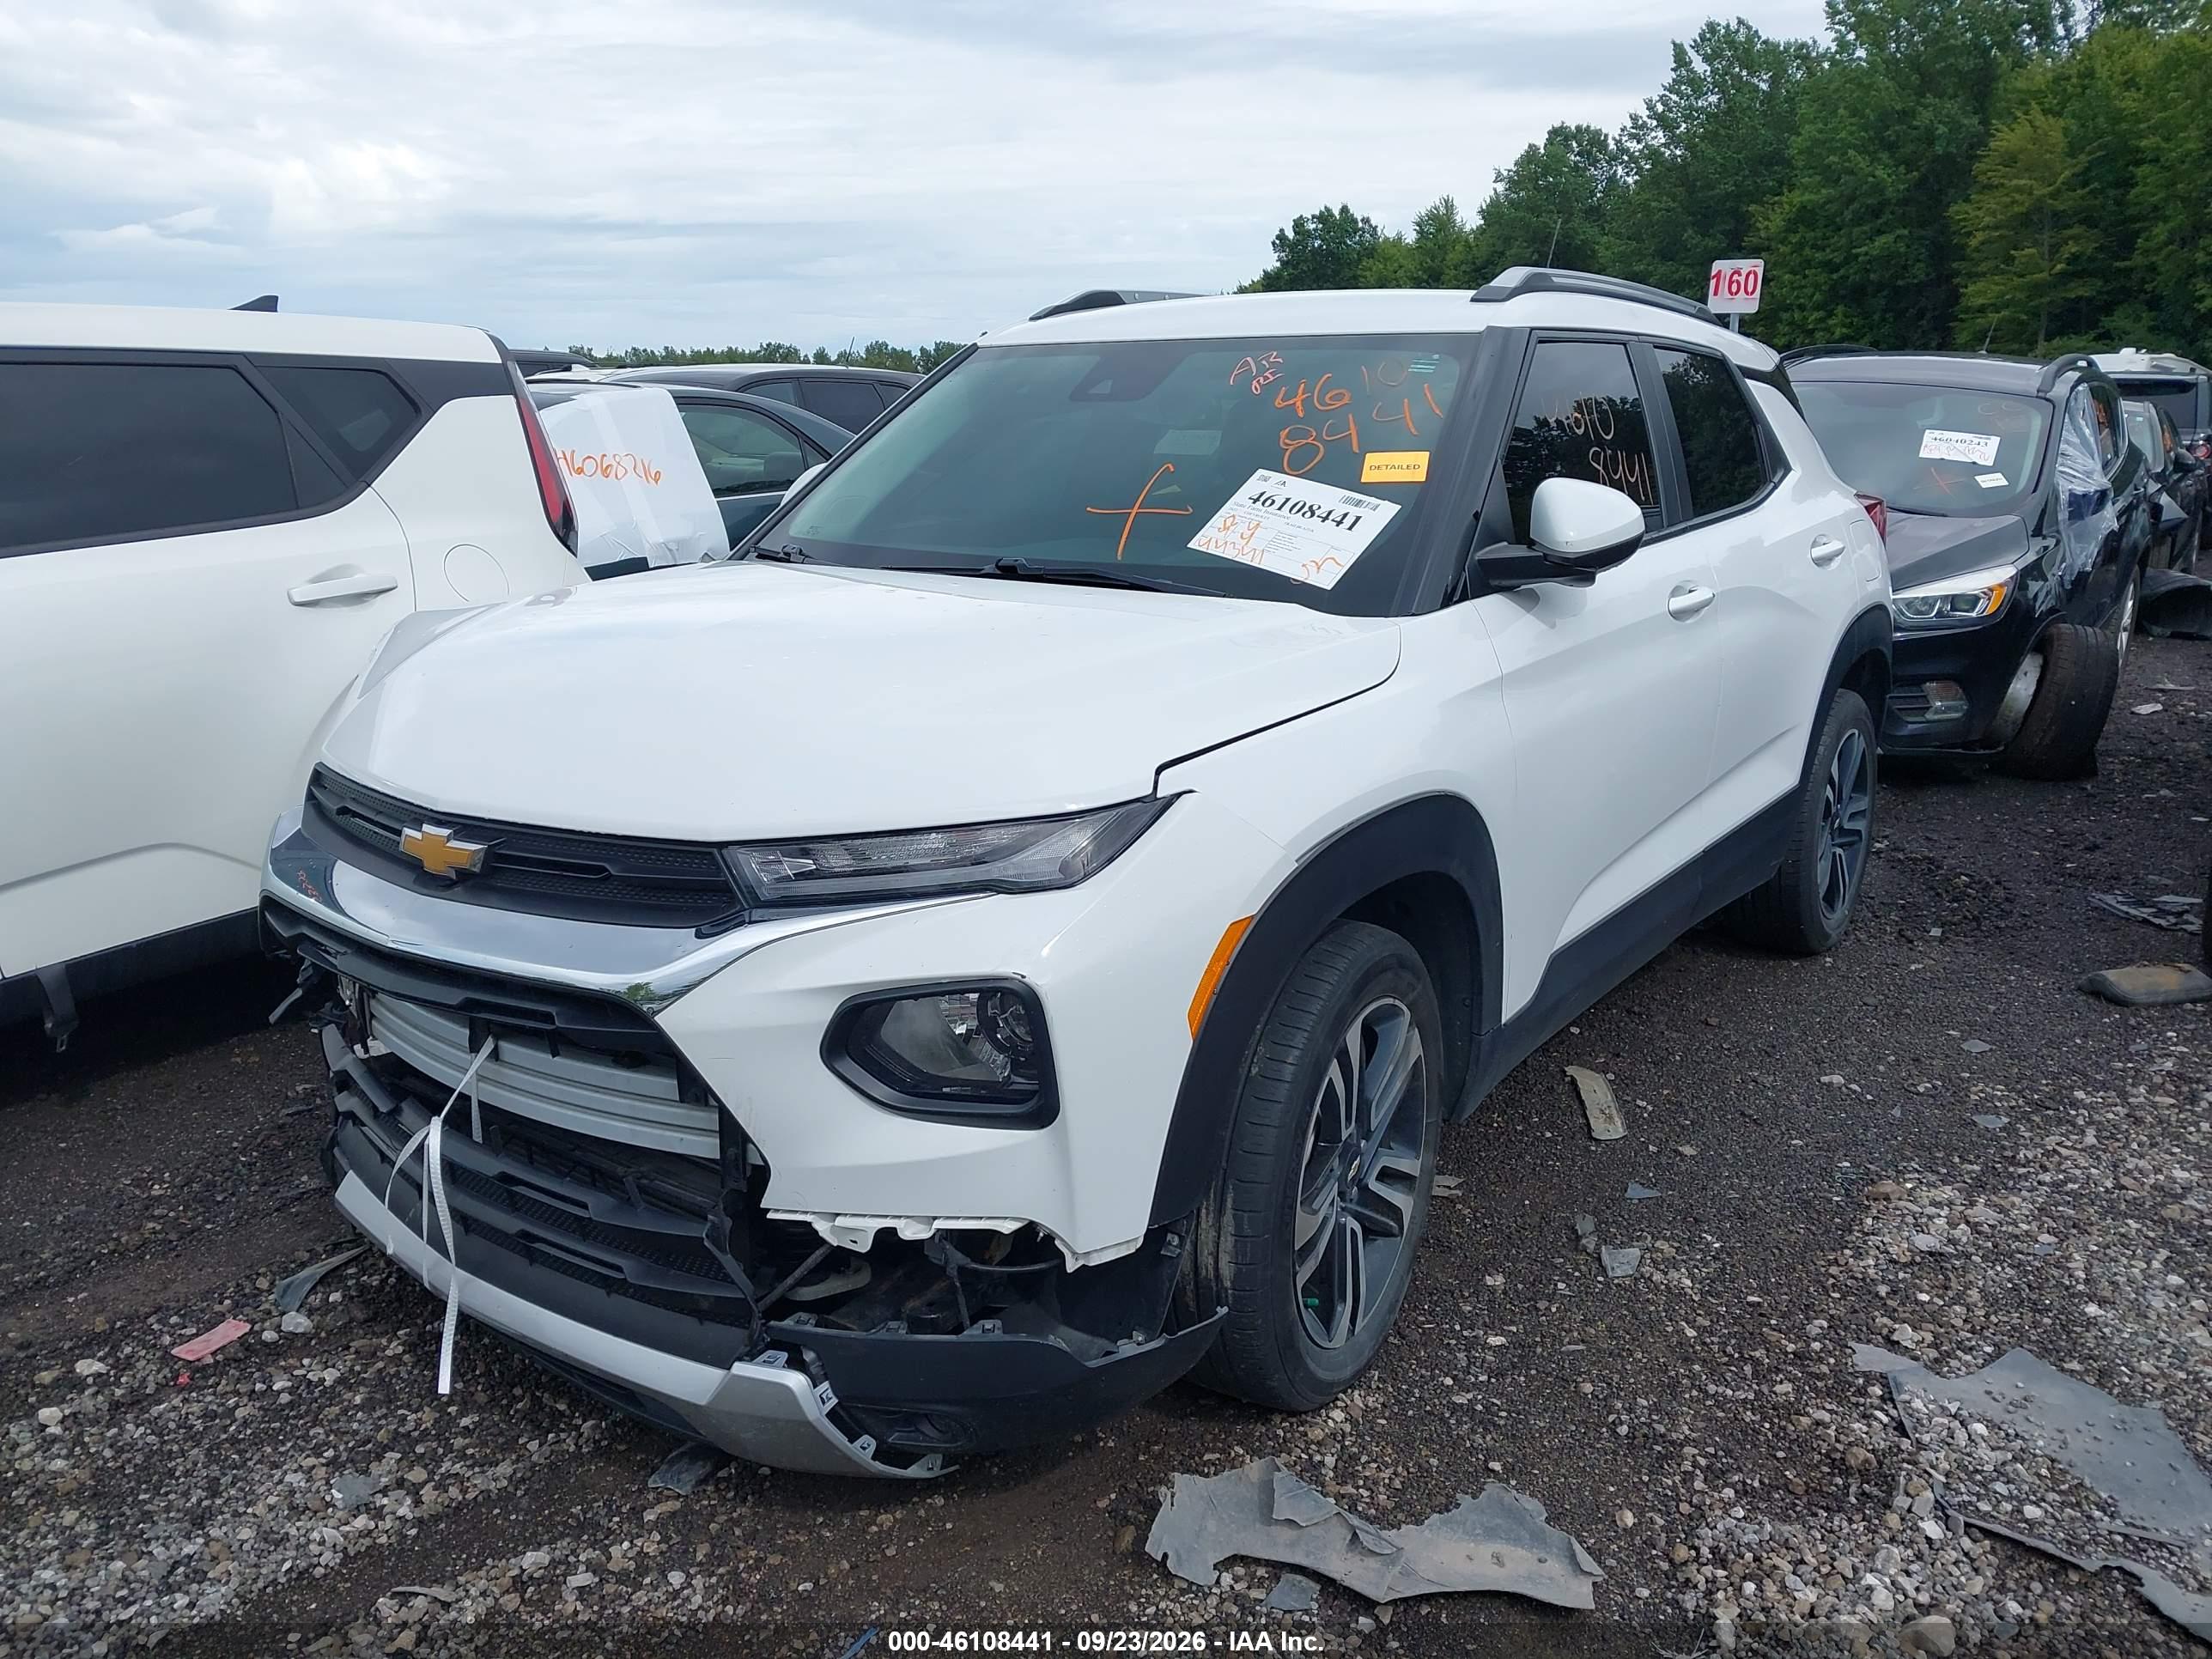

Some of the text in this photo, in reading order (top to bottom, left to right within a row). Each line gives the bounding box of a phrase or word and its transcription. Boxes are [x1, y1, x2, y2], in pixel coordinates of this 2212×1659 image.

[1711, 269, 1759, 296] 160
[1369, 463, 1422, 472] DETAILED
[1247, 490, 1364, 532] 46108441
